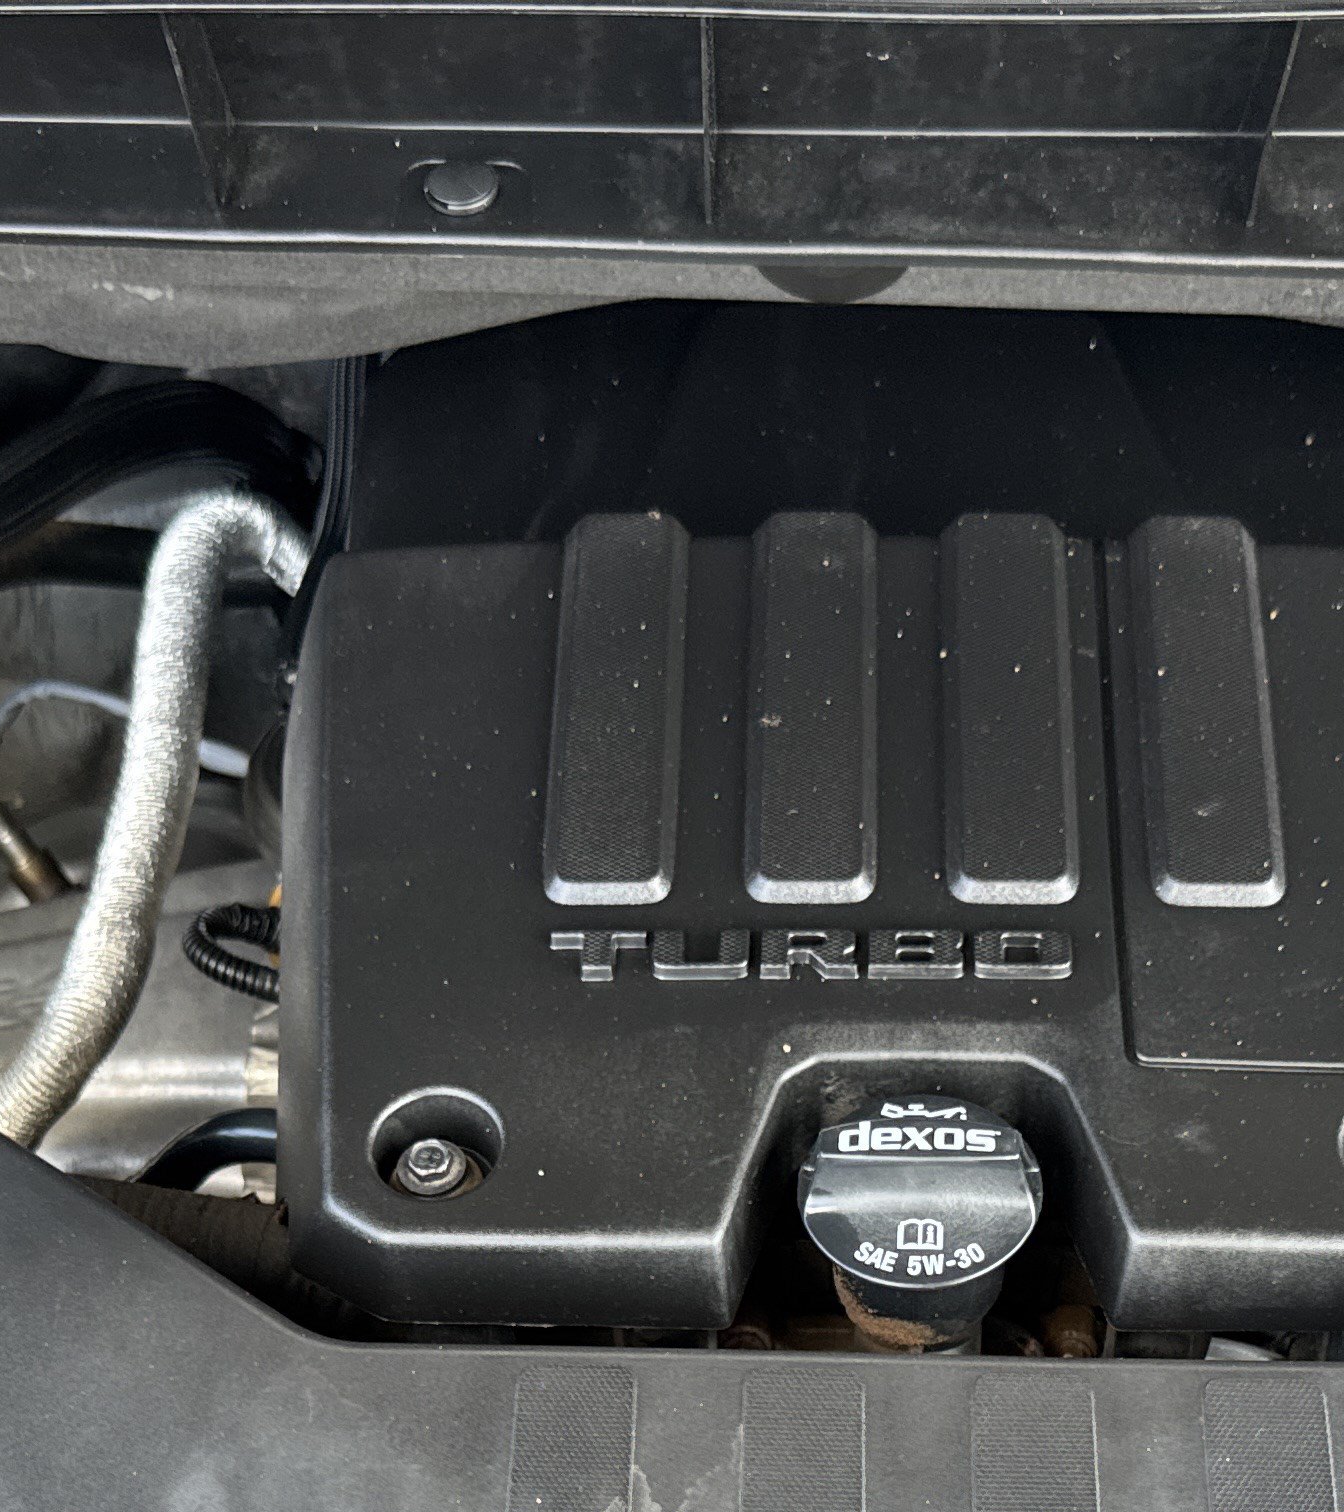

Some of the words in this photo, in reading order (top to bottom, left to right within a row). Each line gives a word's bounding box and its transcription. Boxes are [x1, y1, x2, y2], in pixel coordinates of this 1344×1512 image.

[550, 929, 1073, 982] TURBO
[838, 1121, 997, 1152] dexos
[854, 1242, 899, 1273] SAE
[906, 1243, 985, 1276] 5W-30
